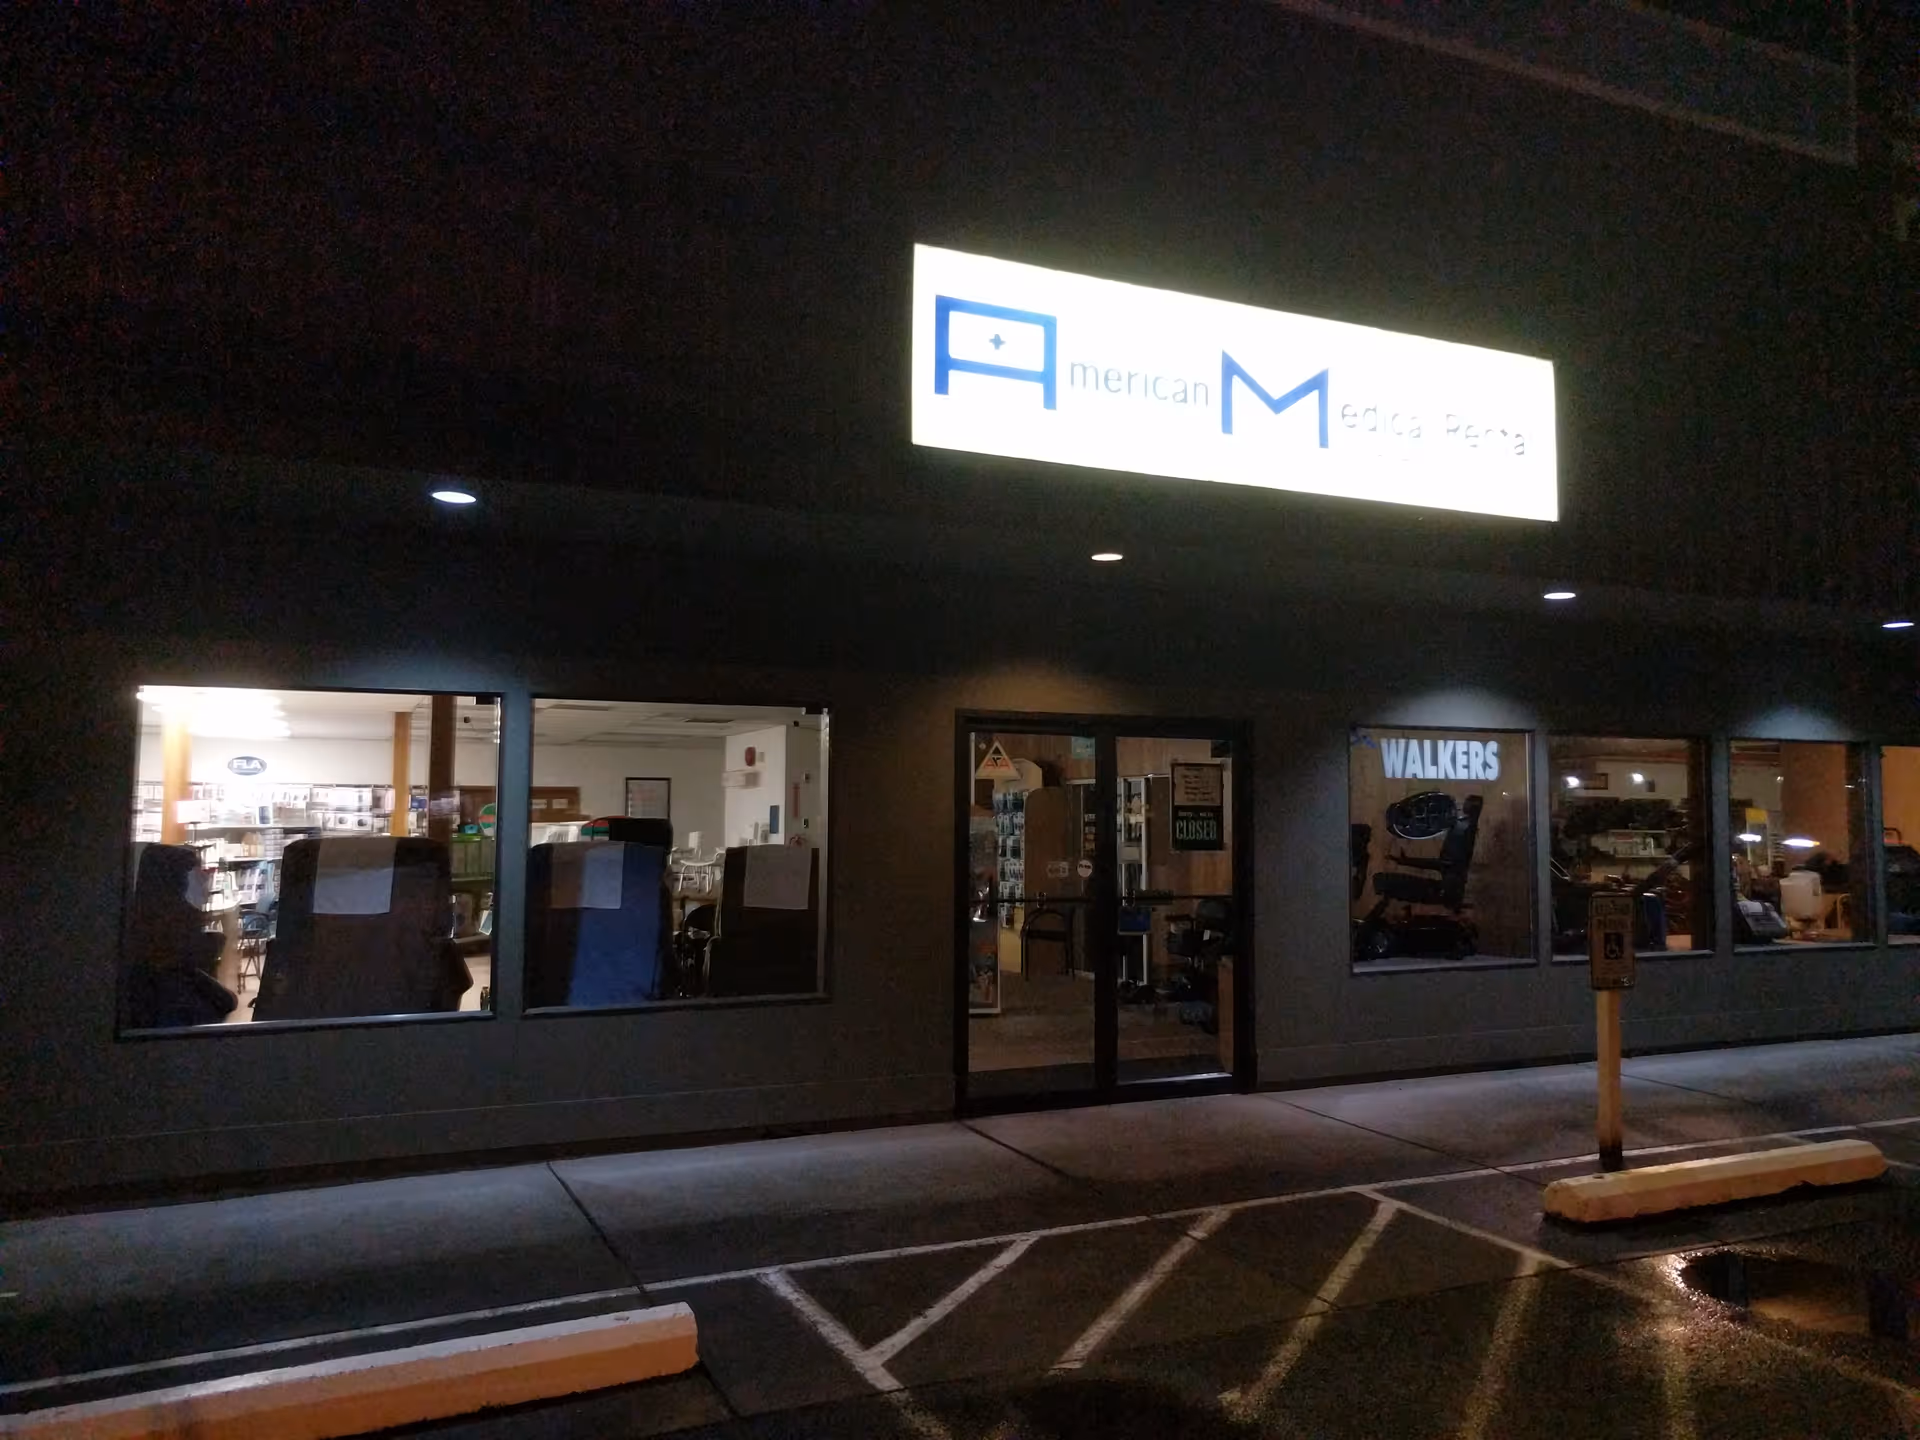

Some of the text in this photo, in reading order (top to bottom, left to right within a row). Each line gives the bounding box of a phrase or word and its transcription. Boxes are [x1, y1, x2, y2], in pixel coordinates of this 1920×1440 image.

[935, 294, 1209, 411] American
[1221, 349, 1429, 449] Medica
[1380, 738, 1500, 781] WALKERS
[1175, 819, 1217, 840] CLOSED
